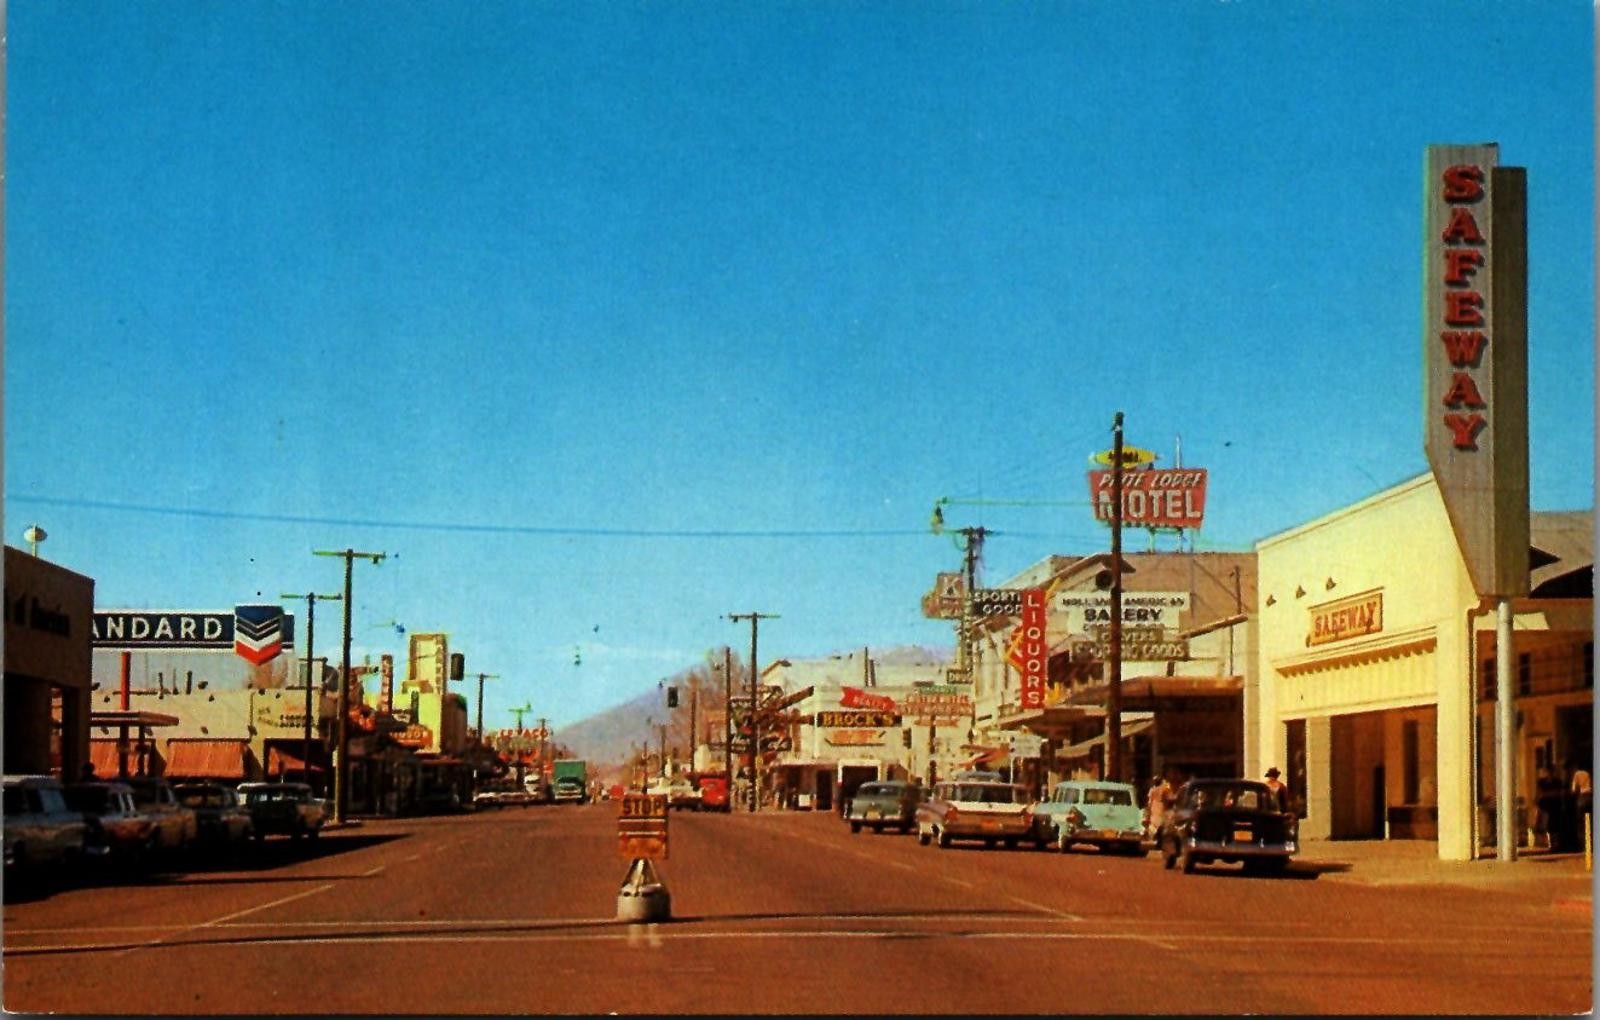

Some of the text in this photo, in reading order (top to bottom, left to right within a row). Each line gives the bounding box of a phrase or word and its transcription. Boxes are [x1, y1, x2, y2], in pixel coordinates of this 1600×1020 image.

[1441, 164, 1487, 450] SAFEWAY
[1149, 472, 1203, 488] LODGE
[1098, 489, 1202, 519] MOTEL
[1084, 608, 1162, 621] BAERY
[1314, 601, 1377, 637] SAFEWAY
[1026, 593, 1041, 705] LIQUORS
[823, 713, 894, 727] BROCK'S
[623, 797, 664, 815] STOP
